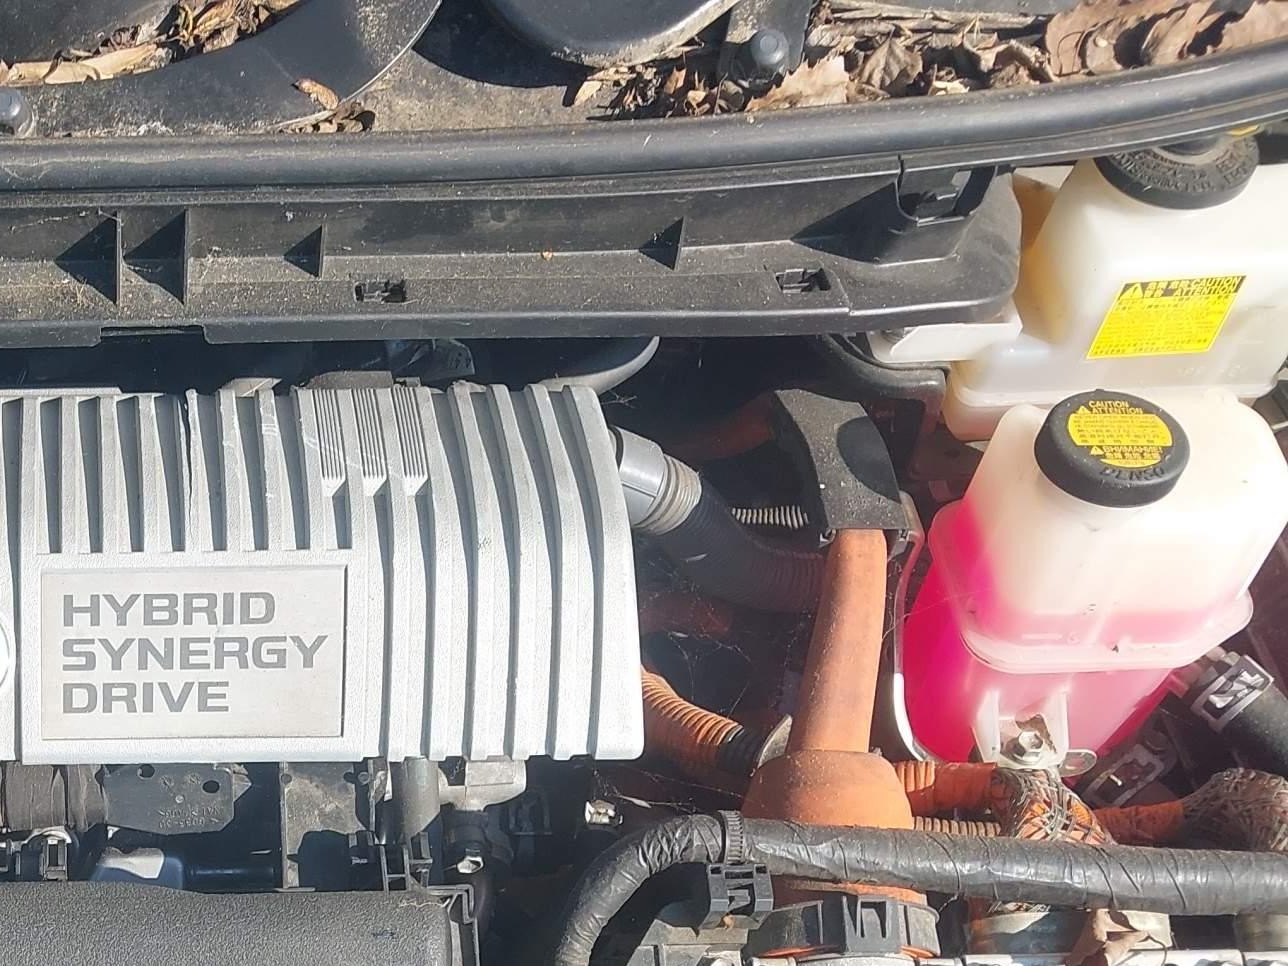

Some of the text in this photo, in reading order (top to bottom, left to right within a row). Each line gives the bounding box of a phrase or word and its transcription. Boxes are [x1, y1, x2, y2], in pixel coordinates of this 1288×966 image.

[1175, 287, 1236, 296] ATTENTION
[1191, 276, 1241, 287] CAUTION
[1100, 467, 1165, 481] DENSO
[63, 592, 275, 627] HYBRID
[62, 635, 328, 671] SYNERGY
[62, 681, 229, 713] DRIVE
